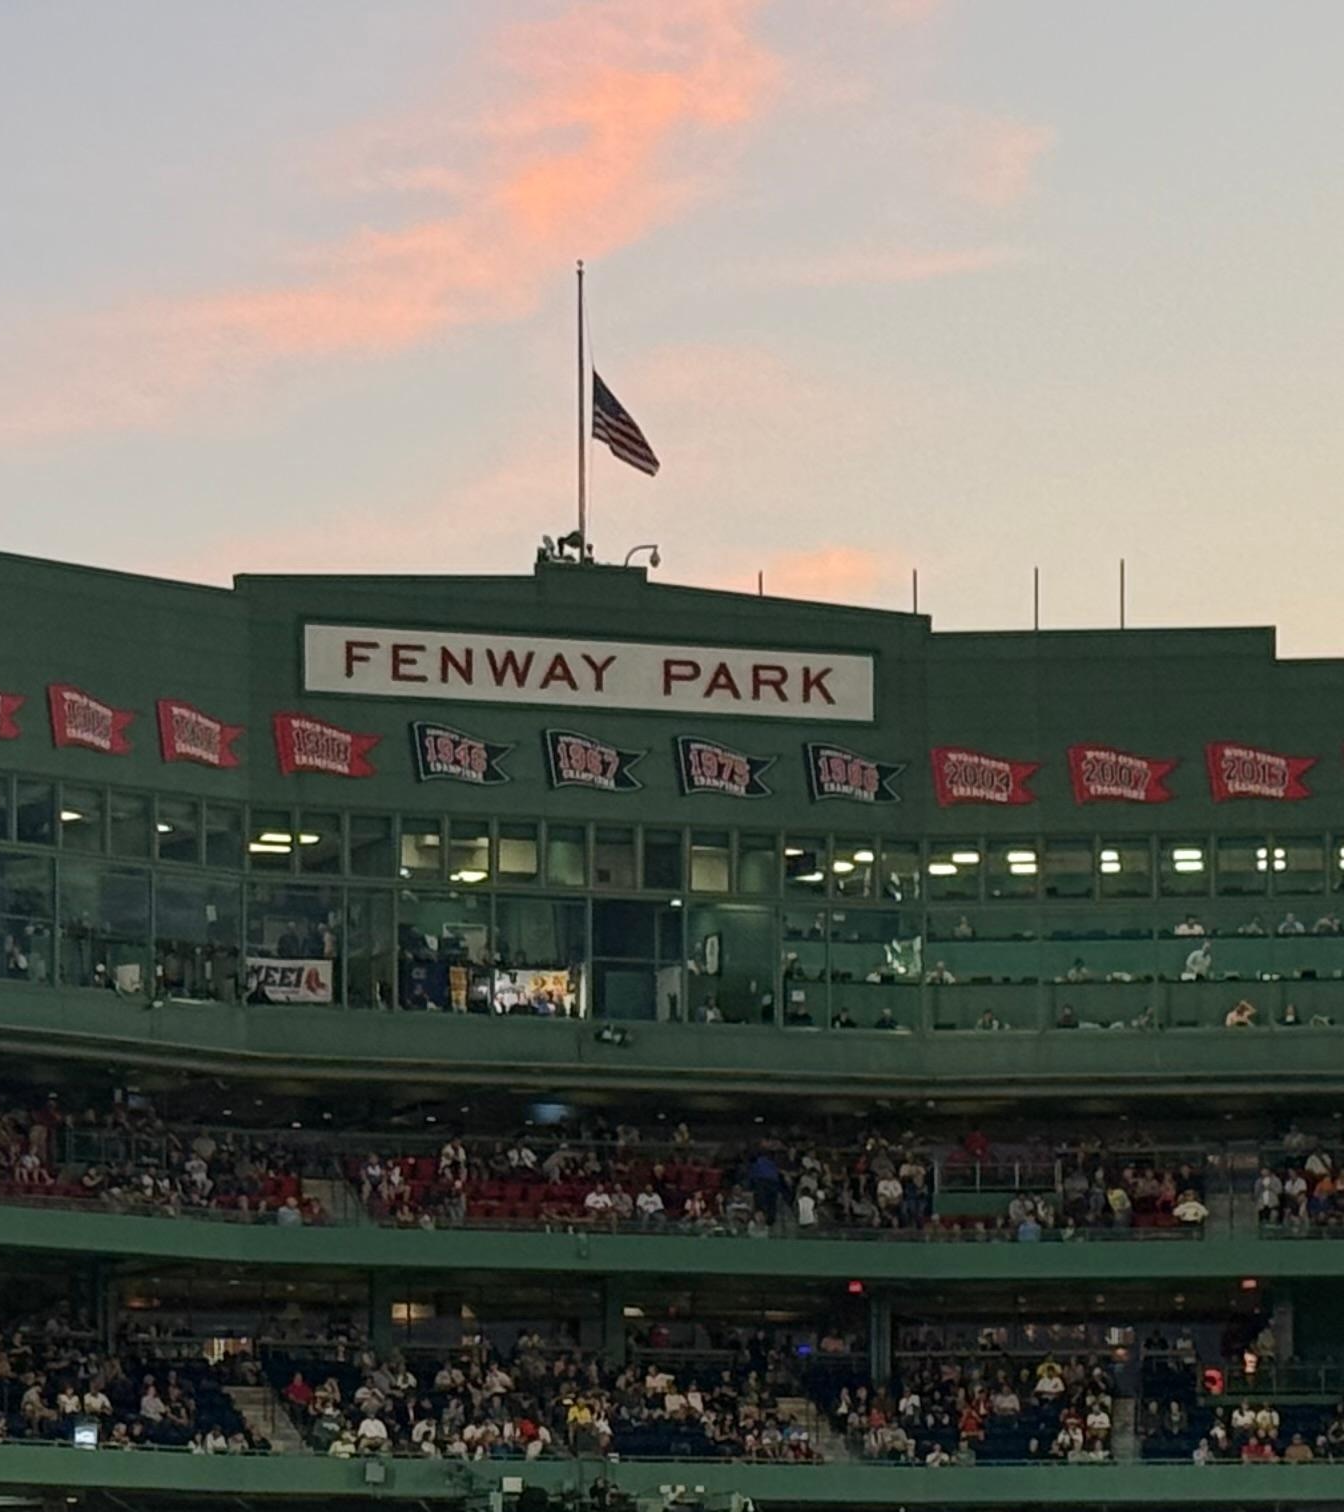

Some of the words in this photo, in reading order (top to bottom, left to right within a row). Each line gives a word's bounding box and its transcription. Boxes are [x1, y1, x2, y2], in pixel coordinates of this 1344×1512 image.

[344, 640, 617, 692] FENWAY
[661, 658, 836, 705] PARK
[425, 736, 487, 773] 1946
[557, 743, 619, 778] 1967
[689, 750, 750, 786] 1975
[944, 762, 1013, 794] 2004
[1082, 759, 1151, 790] 2007
[1222, 759, 1288, 789] 2013
